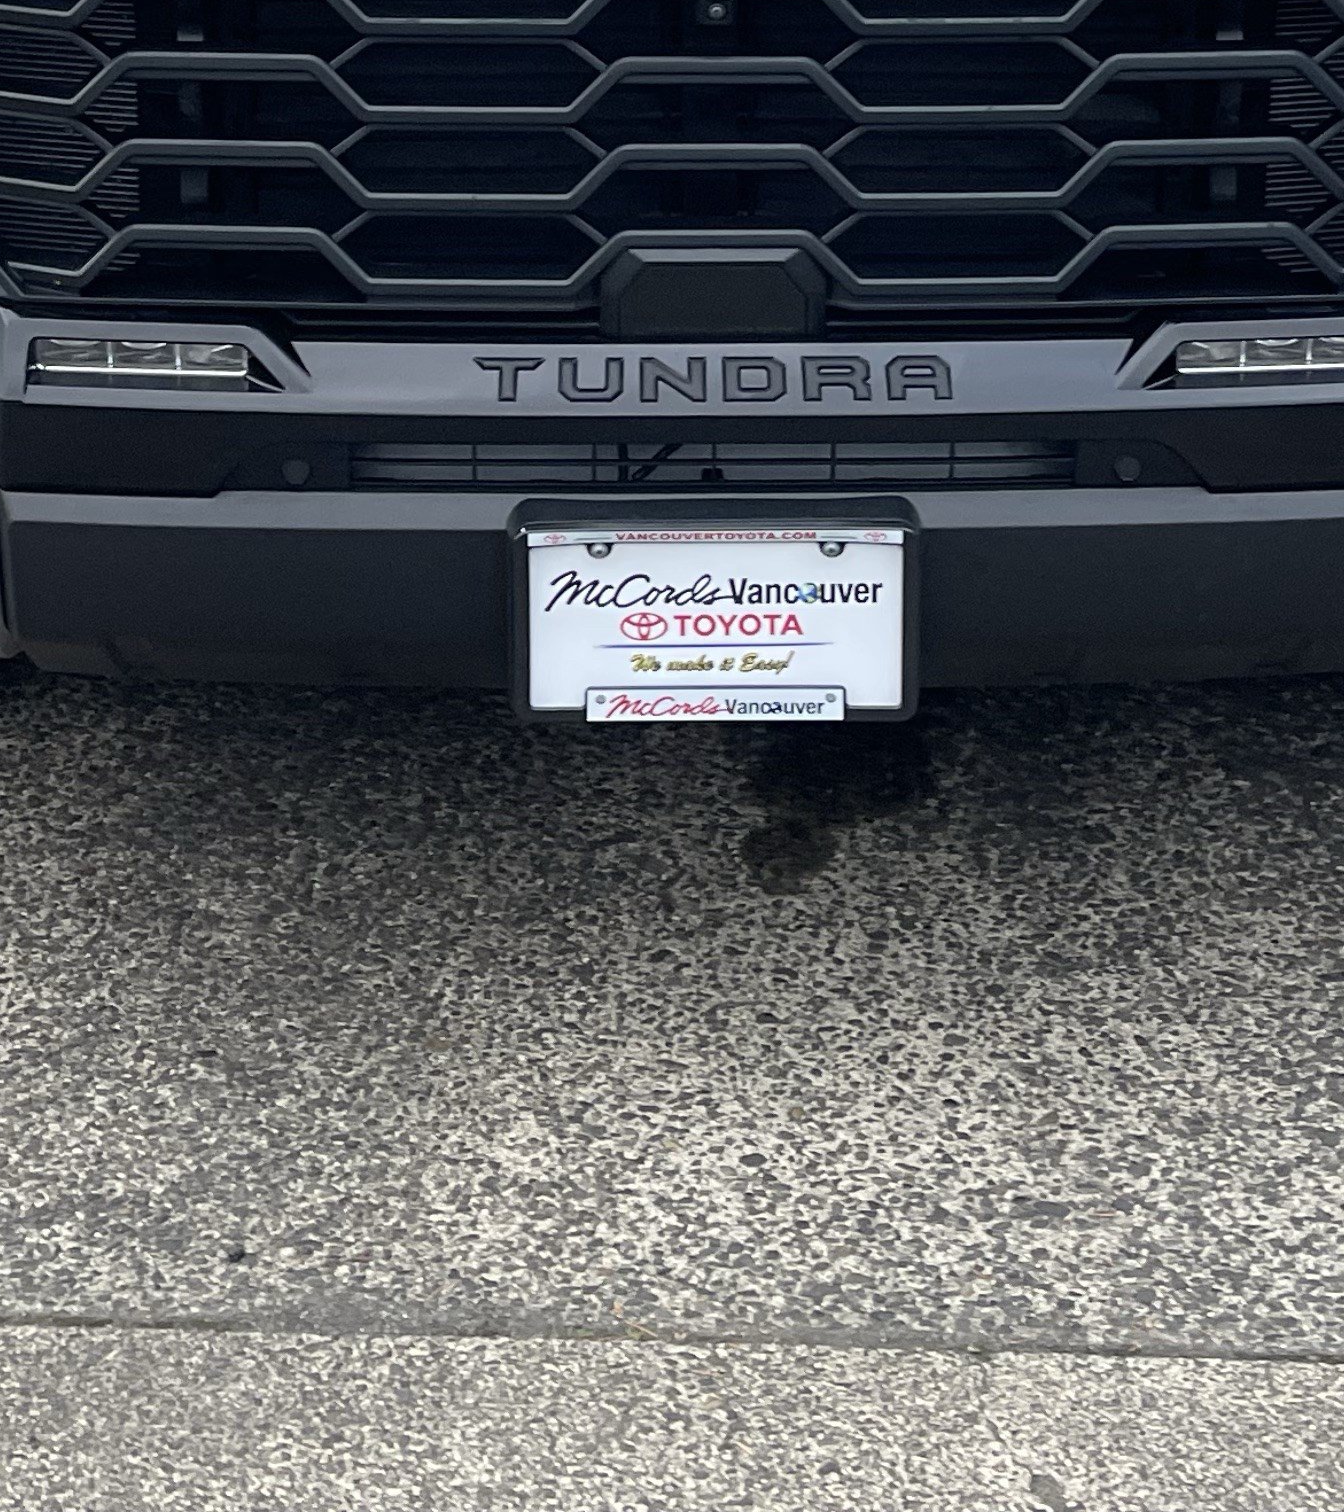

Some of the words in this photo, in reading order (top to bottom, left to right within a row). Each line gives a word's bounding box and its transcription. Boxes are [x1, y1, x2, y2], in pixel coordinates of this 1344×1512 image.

[472, 354, 954, 403] TUNDRA
[615, 531, 817, 541] VANCOUVERTOYOTA.COM
[545, 569, 732, 613] McCords
[728, 577, 883, 605] Vancouver
[673, 613, 804, 637] TOYOTA
[630, 652, 662, 672] We
[605, 694, 728, 719] McCords
[724, 697, 826, 715] Vancouver
